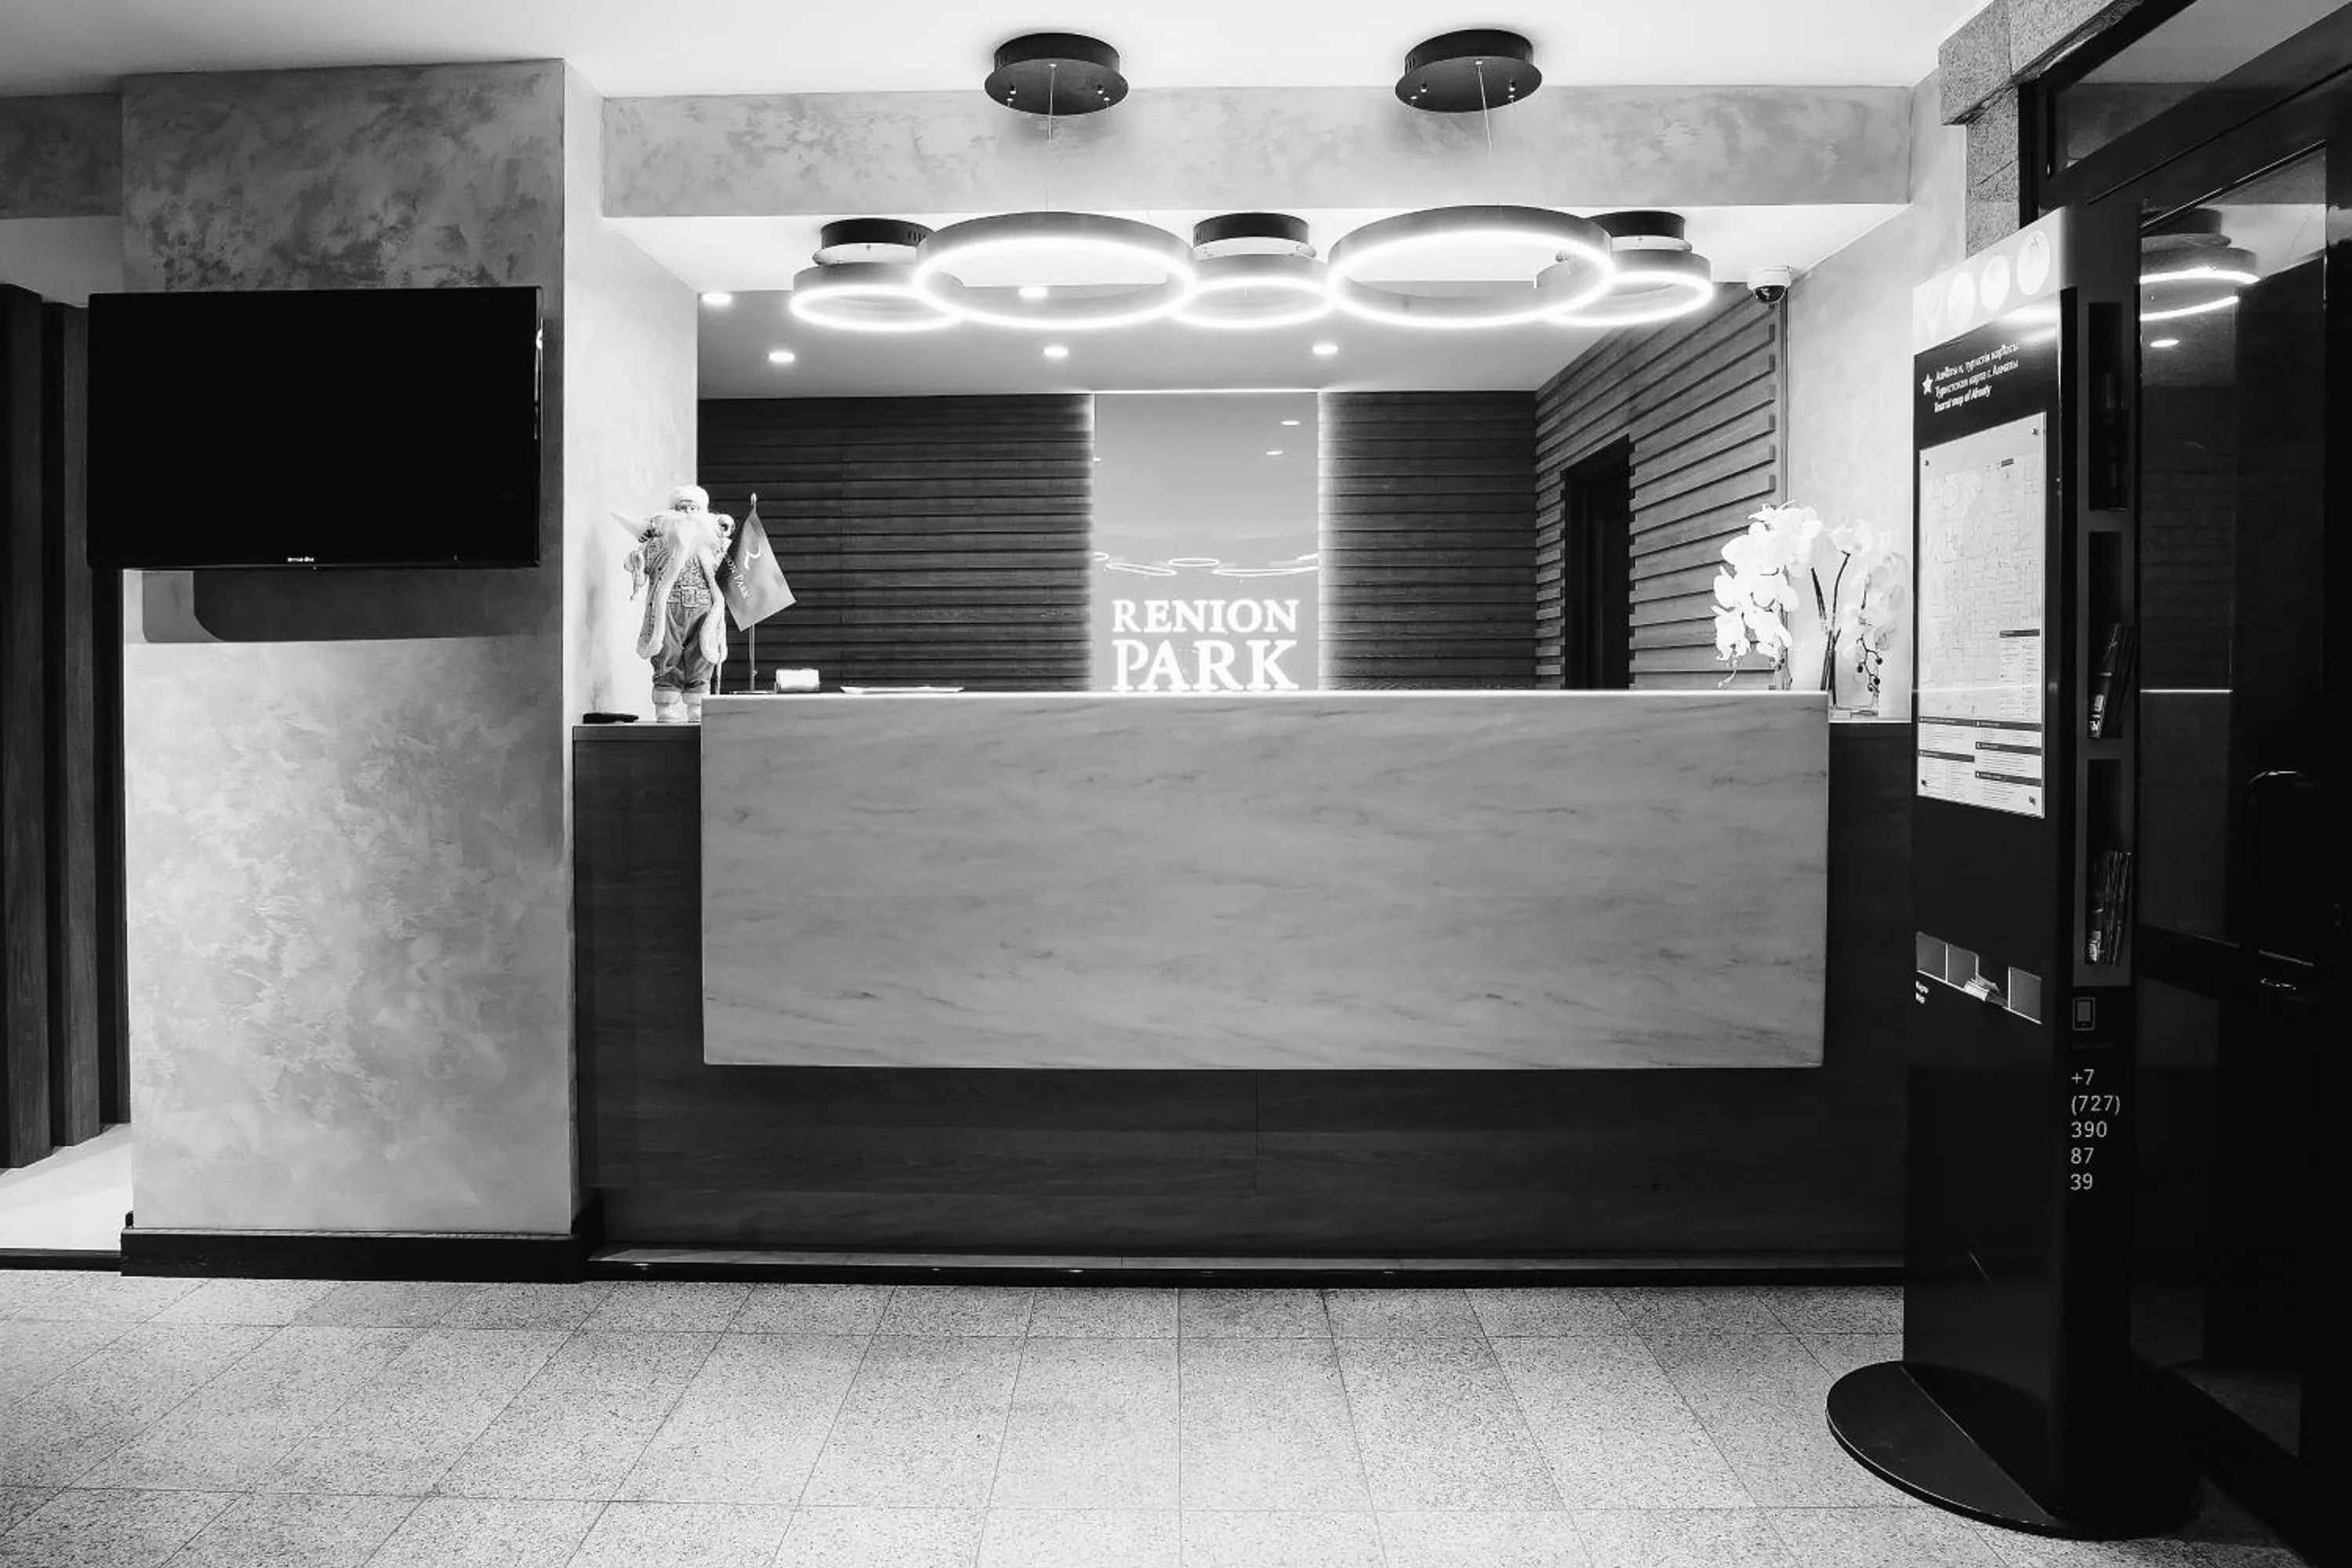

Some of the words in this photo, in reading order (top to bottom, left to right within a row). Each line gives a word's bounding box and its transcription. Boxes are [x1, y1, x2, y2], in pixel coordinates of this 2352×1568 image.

[1111, 598, 1300, 633] RENION
[1111, 639, 1300, 691] PARK
[2071, 1069, 2094, 1085] +7
[2071, 1095, 2120, 1116] (727)
[2071, 1120, 2107, 1138] 390
[2071, 1147, 2094, 1164] 87
[2071, 1173, 2093, 1190] 39
